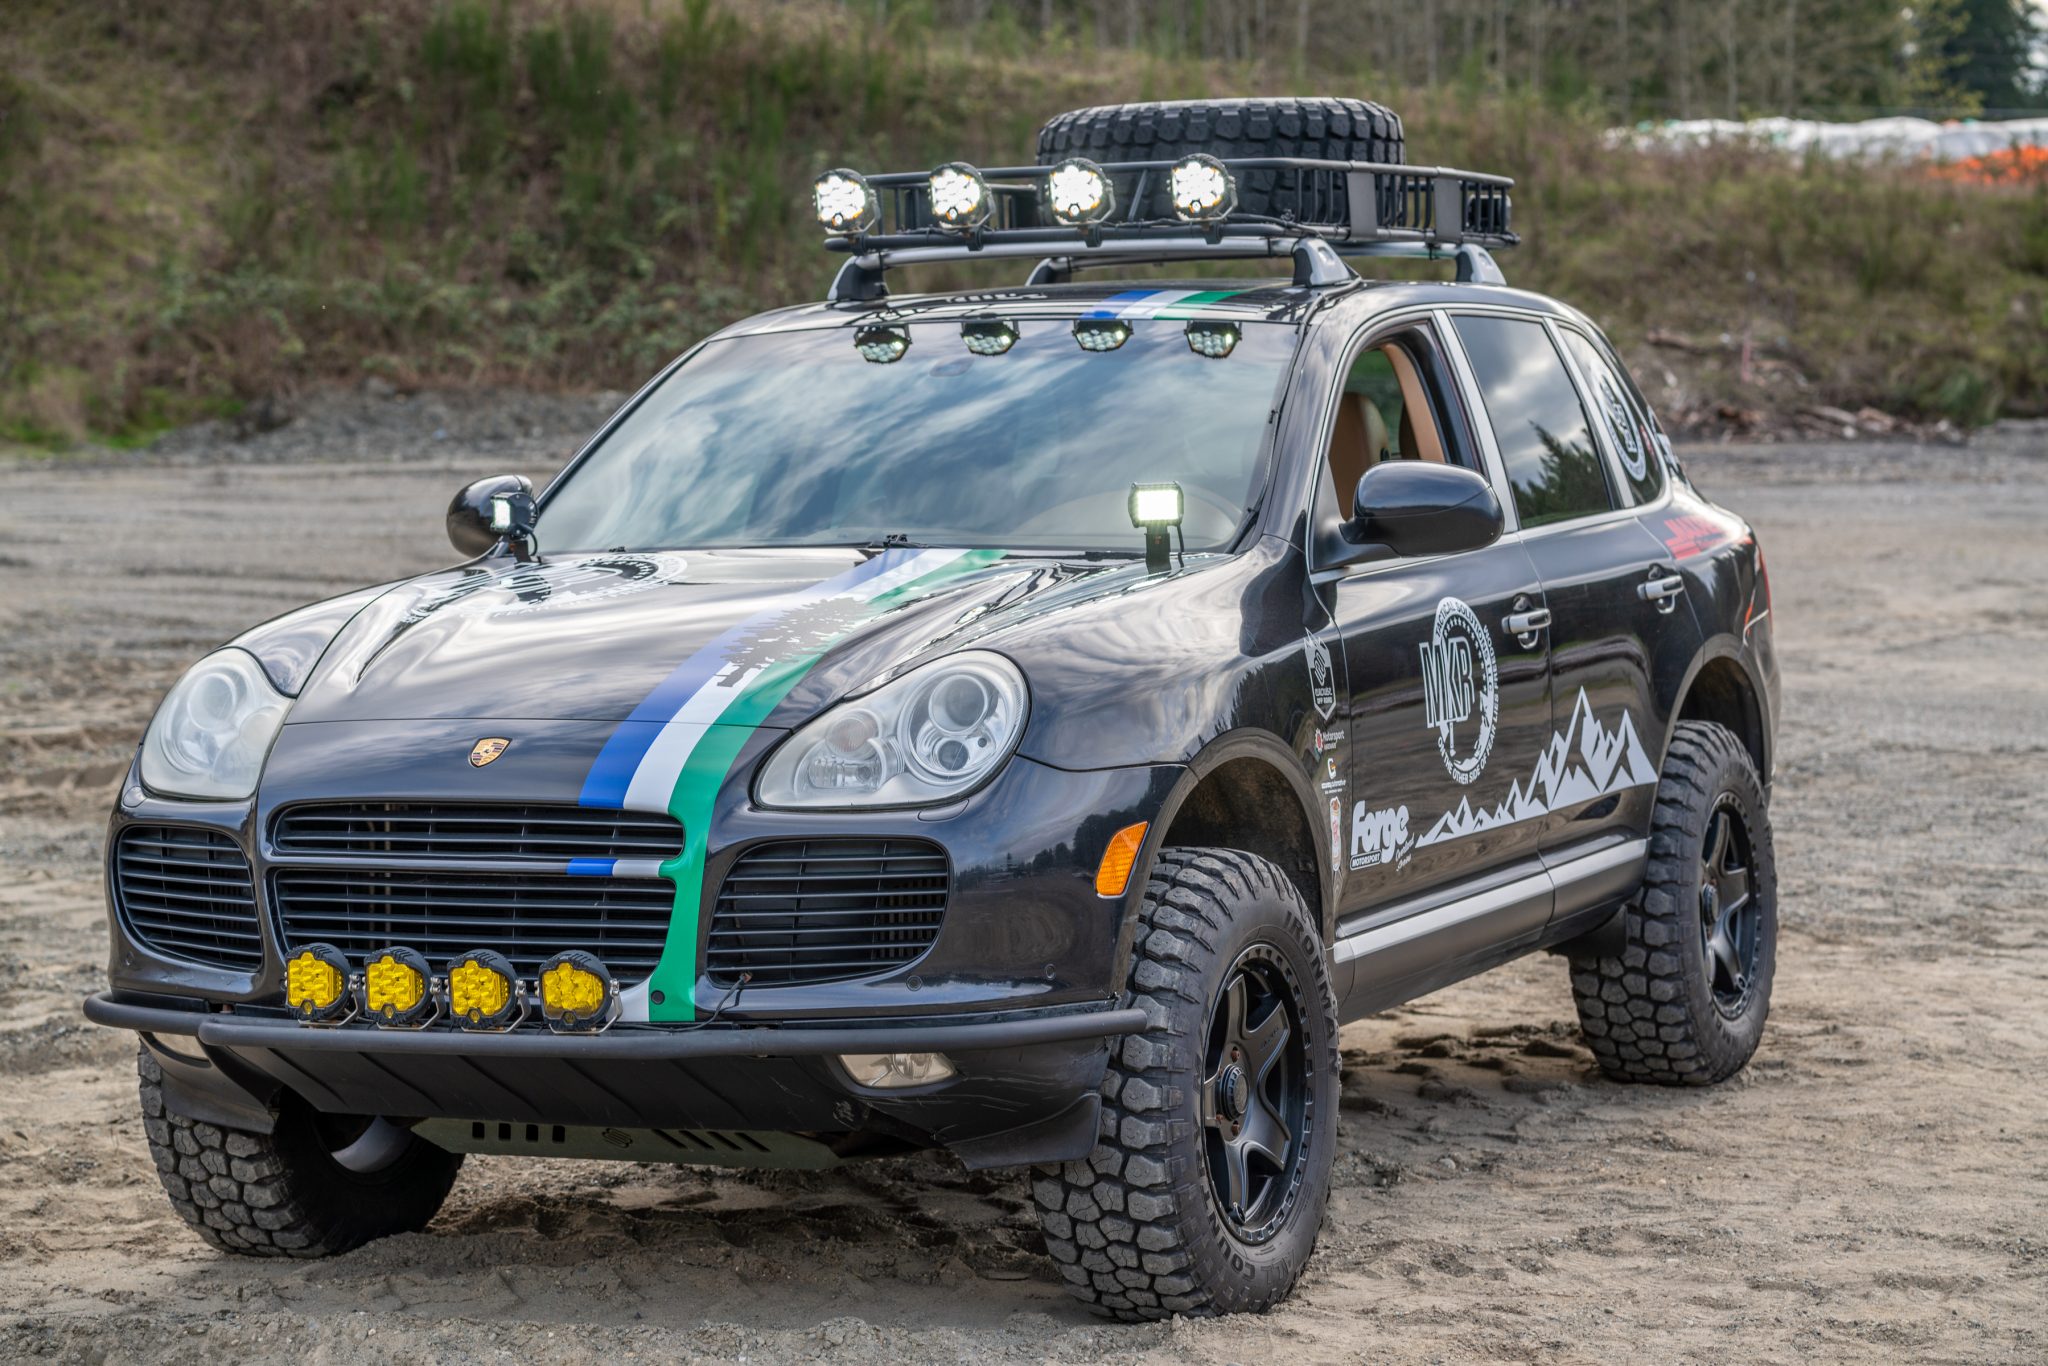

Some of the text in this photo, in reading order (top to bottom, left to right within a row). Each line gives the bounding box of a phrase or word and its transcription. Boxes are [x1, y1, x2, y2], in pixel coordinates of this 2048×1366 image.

[1435, 602, 1457, 637] TACTICAL
[1455, 602, 1488, 660] SOLUTIONS
[1419, 636, 1475, 728] MKR
[1437, 736, 1446, 757] ON
[1443, 752, 1454, 774] THE
[1452, 768, 1469, 784] OTHER
[1469, 764, 1481, 783] SIDE
[1480, 752, 1487, 769] OF
[1486, 724, 1496, 756] FEAR
[1351, 852, 1381, 868] MOTORSPORT
[1283, 910, 1339, 1077] IRONMAN
